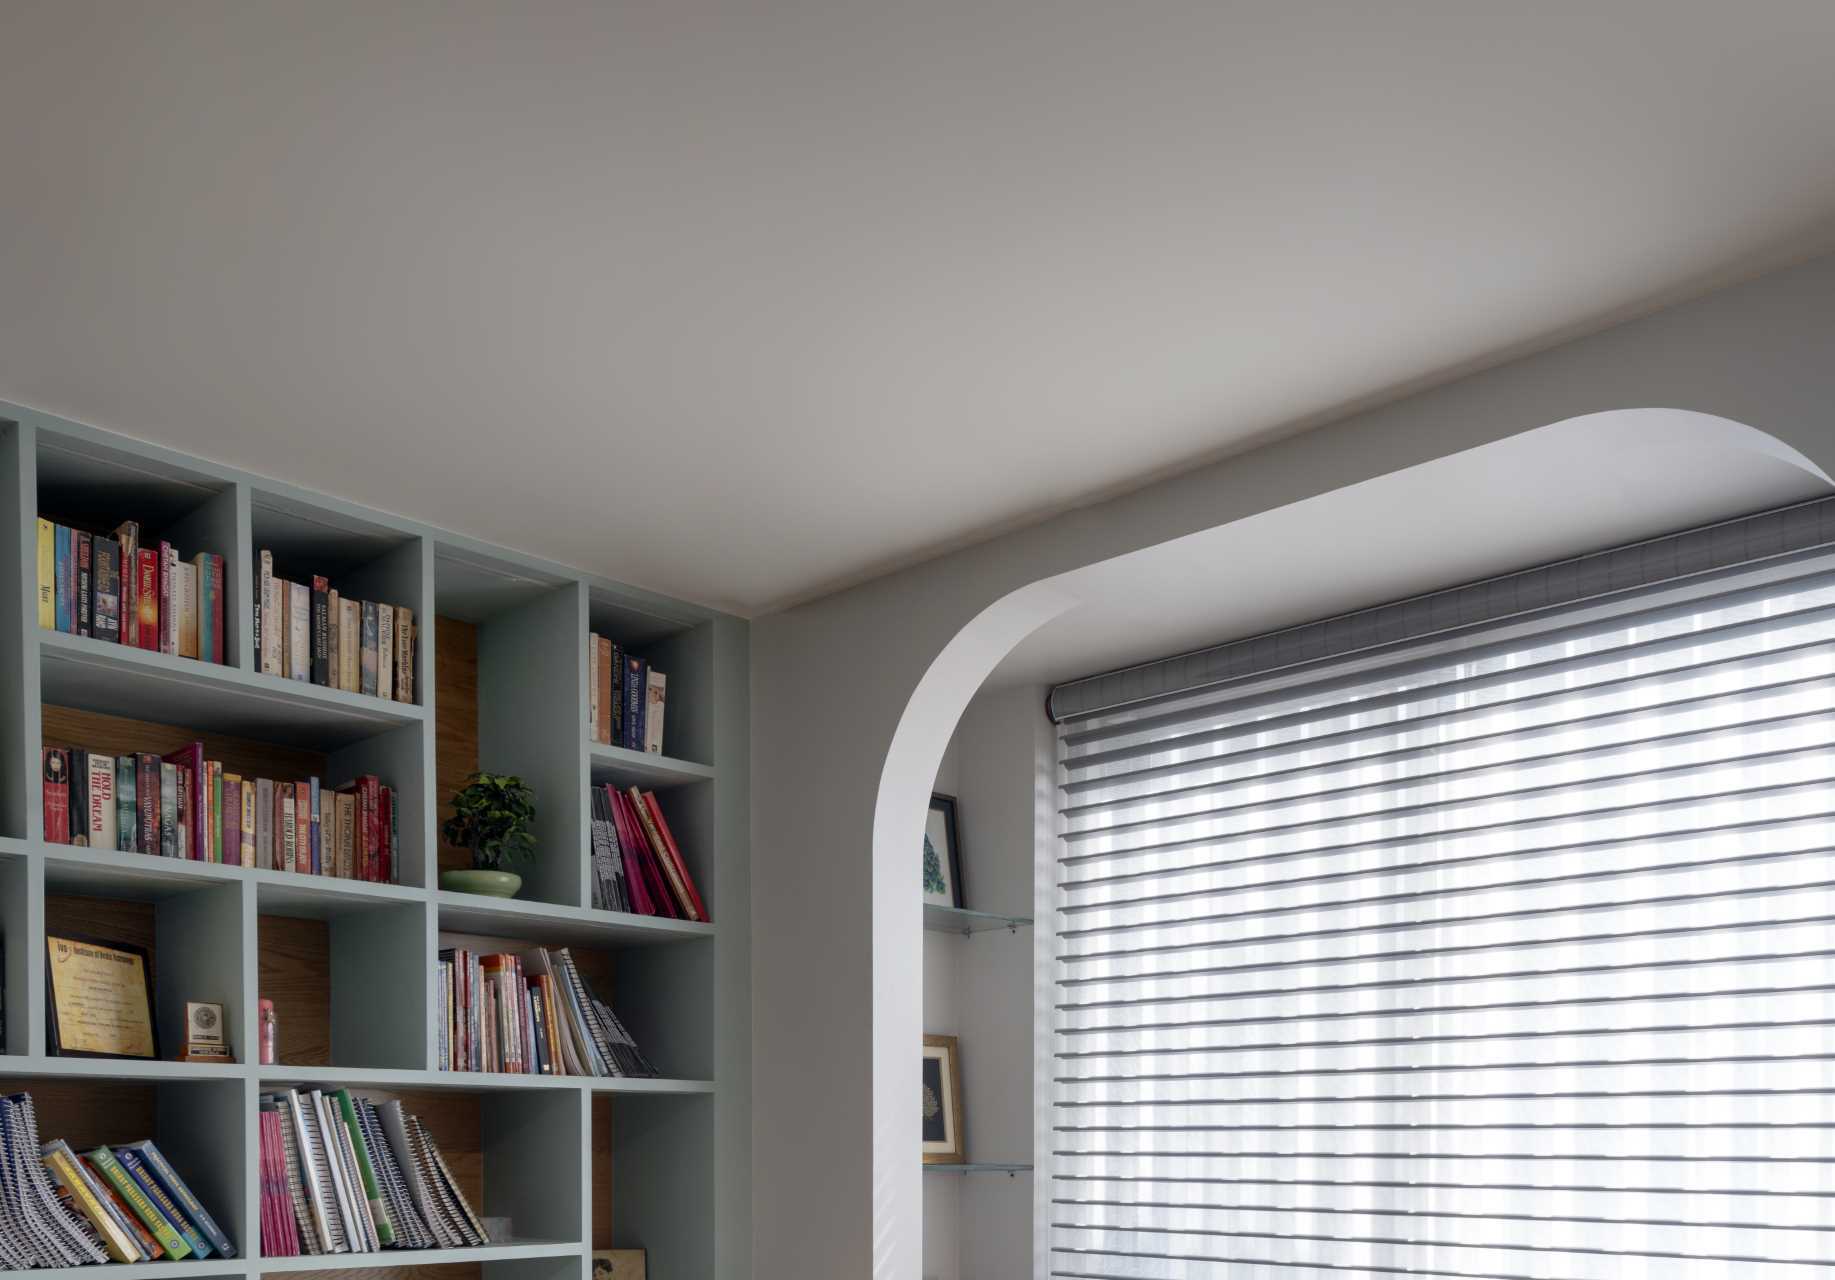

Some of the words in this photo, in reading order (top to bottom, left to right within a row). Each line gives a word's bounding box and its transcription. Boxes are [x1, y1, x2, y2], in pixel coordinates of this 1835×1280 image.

[91, 771, 102, 791] THE
[101, 772, 112, 801] HOLD
[92, 794, 103, 832] DREAM
[143, 797, 152, 841] VAYUPUTRAS
[344, 802, 352, 816] THE
